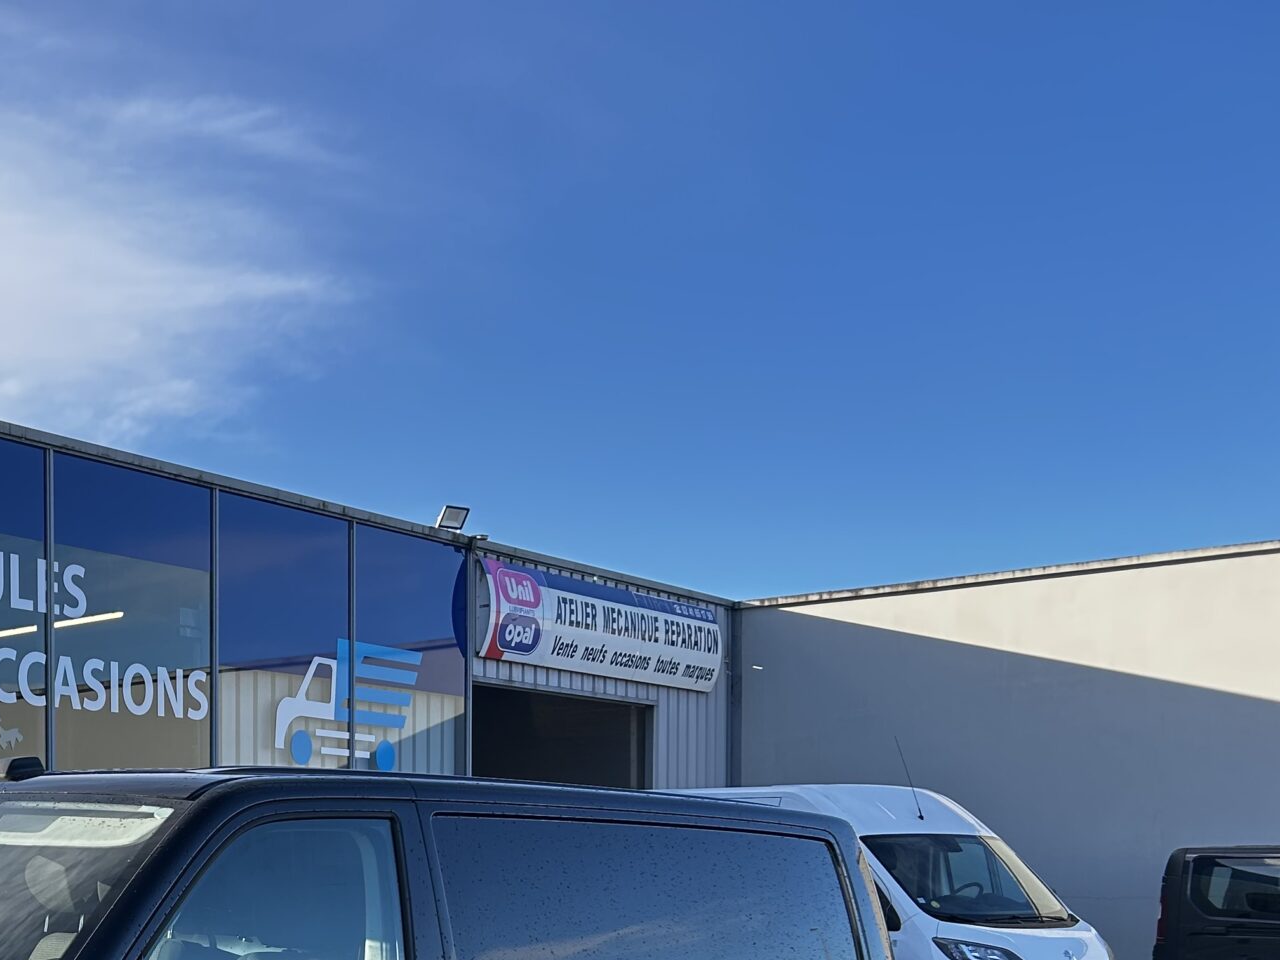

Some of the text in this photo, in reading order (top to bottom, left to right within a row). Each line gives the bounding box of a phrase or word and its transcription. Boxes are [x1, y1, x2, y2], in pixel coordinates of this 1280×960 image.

[504, 576, 535, 603] Unil
[505, 623, 536, 647] opal
[555, 595, 597, 631] ATELIER
[603, 605, 659, 643] MECANIQUE
[664, 618, 719, 655] REPARATION
[551, 635, 715, 684] Vente neufs occasions toutes marques
